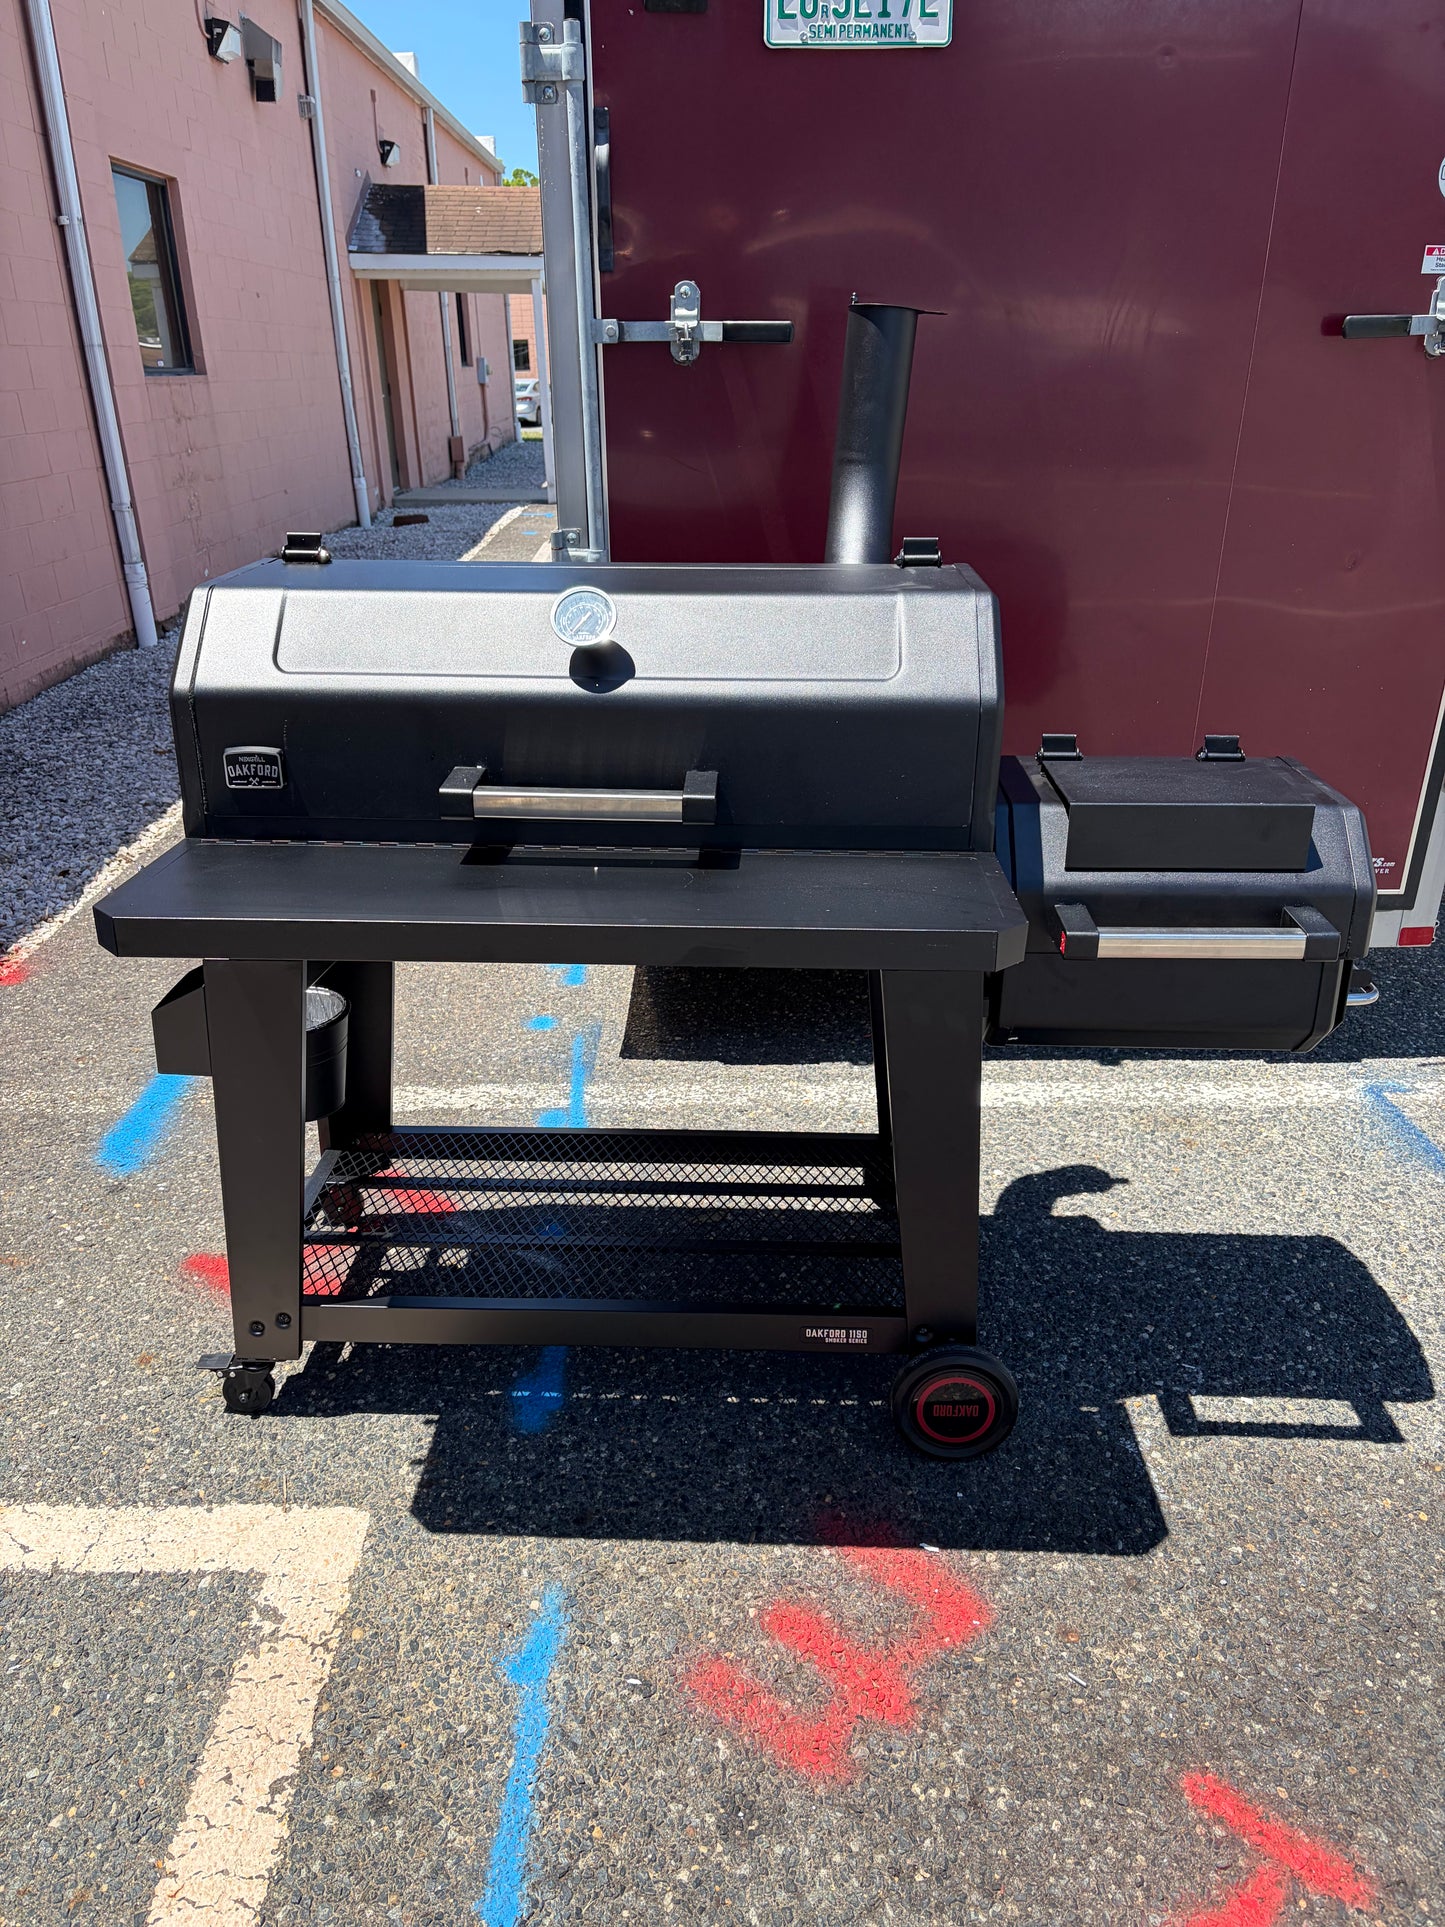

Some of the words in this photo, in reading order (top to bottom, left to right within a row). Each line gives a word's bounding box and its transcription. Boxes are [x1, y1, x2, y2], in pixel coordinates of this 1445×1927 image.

[809, 24, 835, 38] SEMI
[838, 23, 909, 38] PERMANENT
[227, 764, 279, 778] OAKFORD
[805, 1328, 846, 1338] OAKFORD
[933, 1405, 979, 1417] OAKFORD
